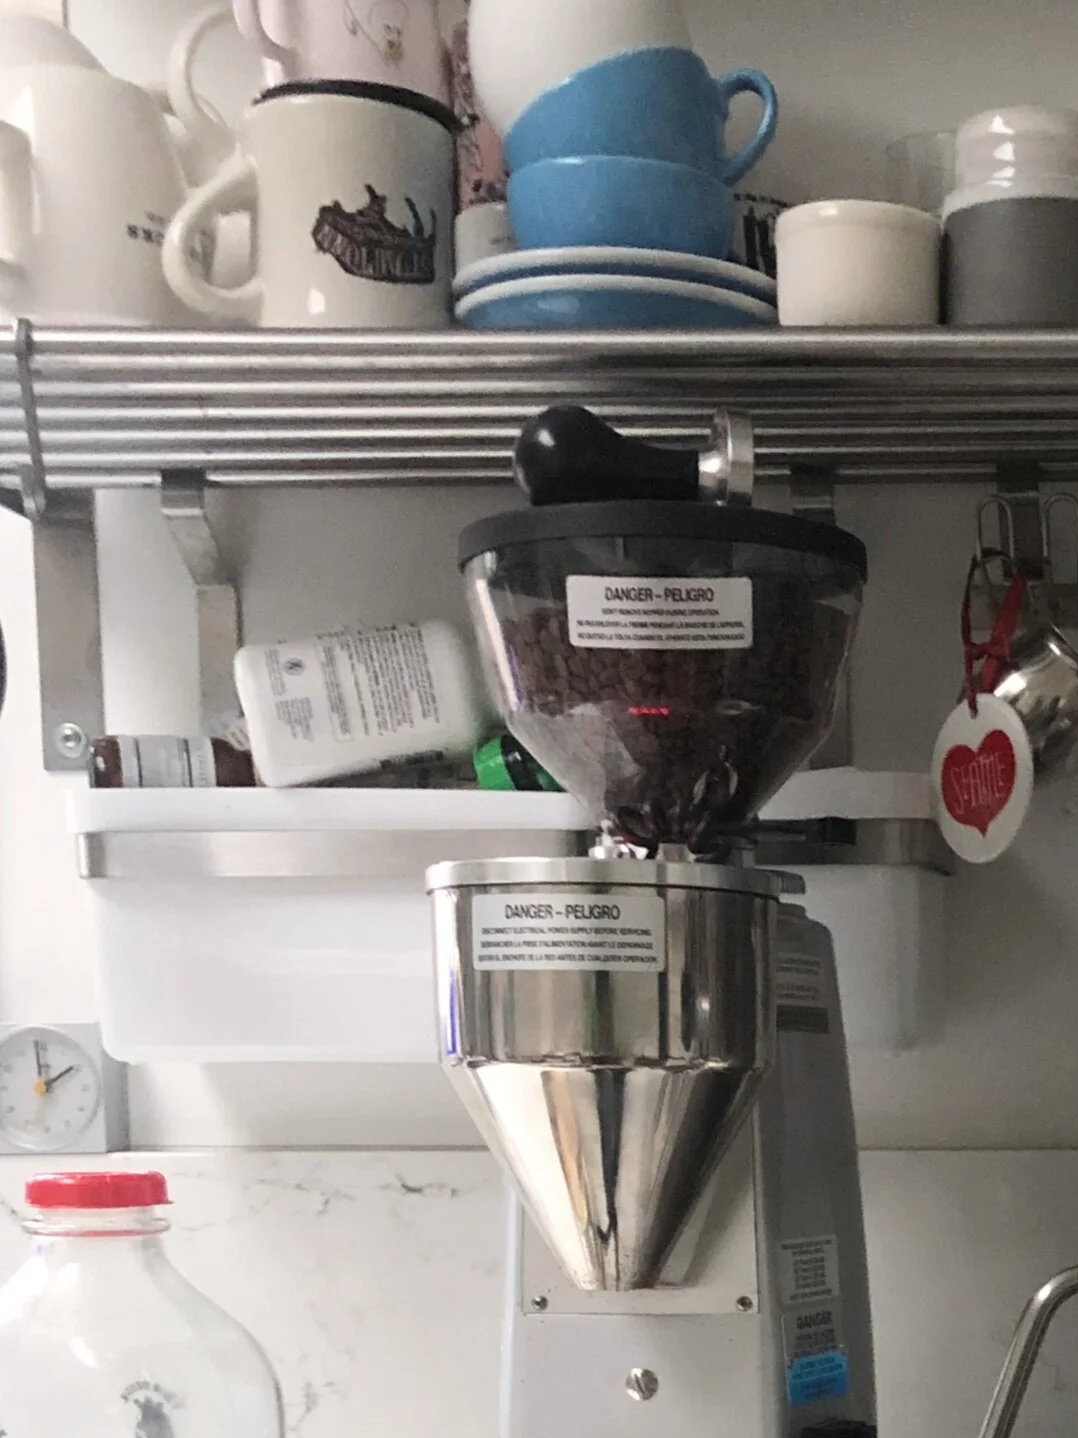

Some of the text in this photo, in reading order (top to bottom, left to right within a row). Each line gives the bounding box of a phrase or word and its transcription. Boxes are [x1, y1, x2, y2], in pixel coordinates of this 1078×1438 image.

[604, 587, 653, 601] DANGER
[663, 587, 715, 602] PELIGRO
[505, 905, 553, 920] DANGER
[565, 905, 621, 920] PELIGRO
